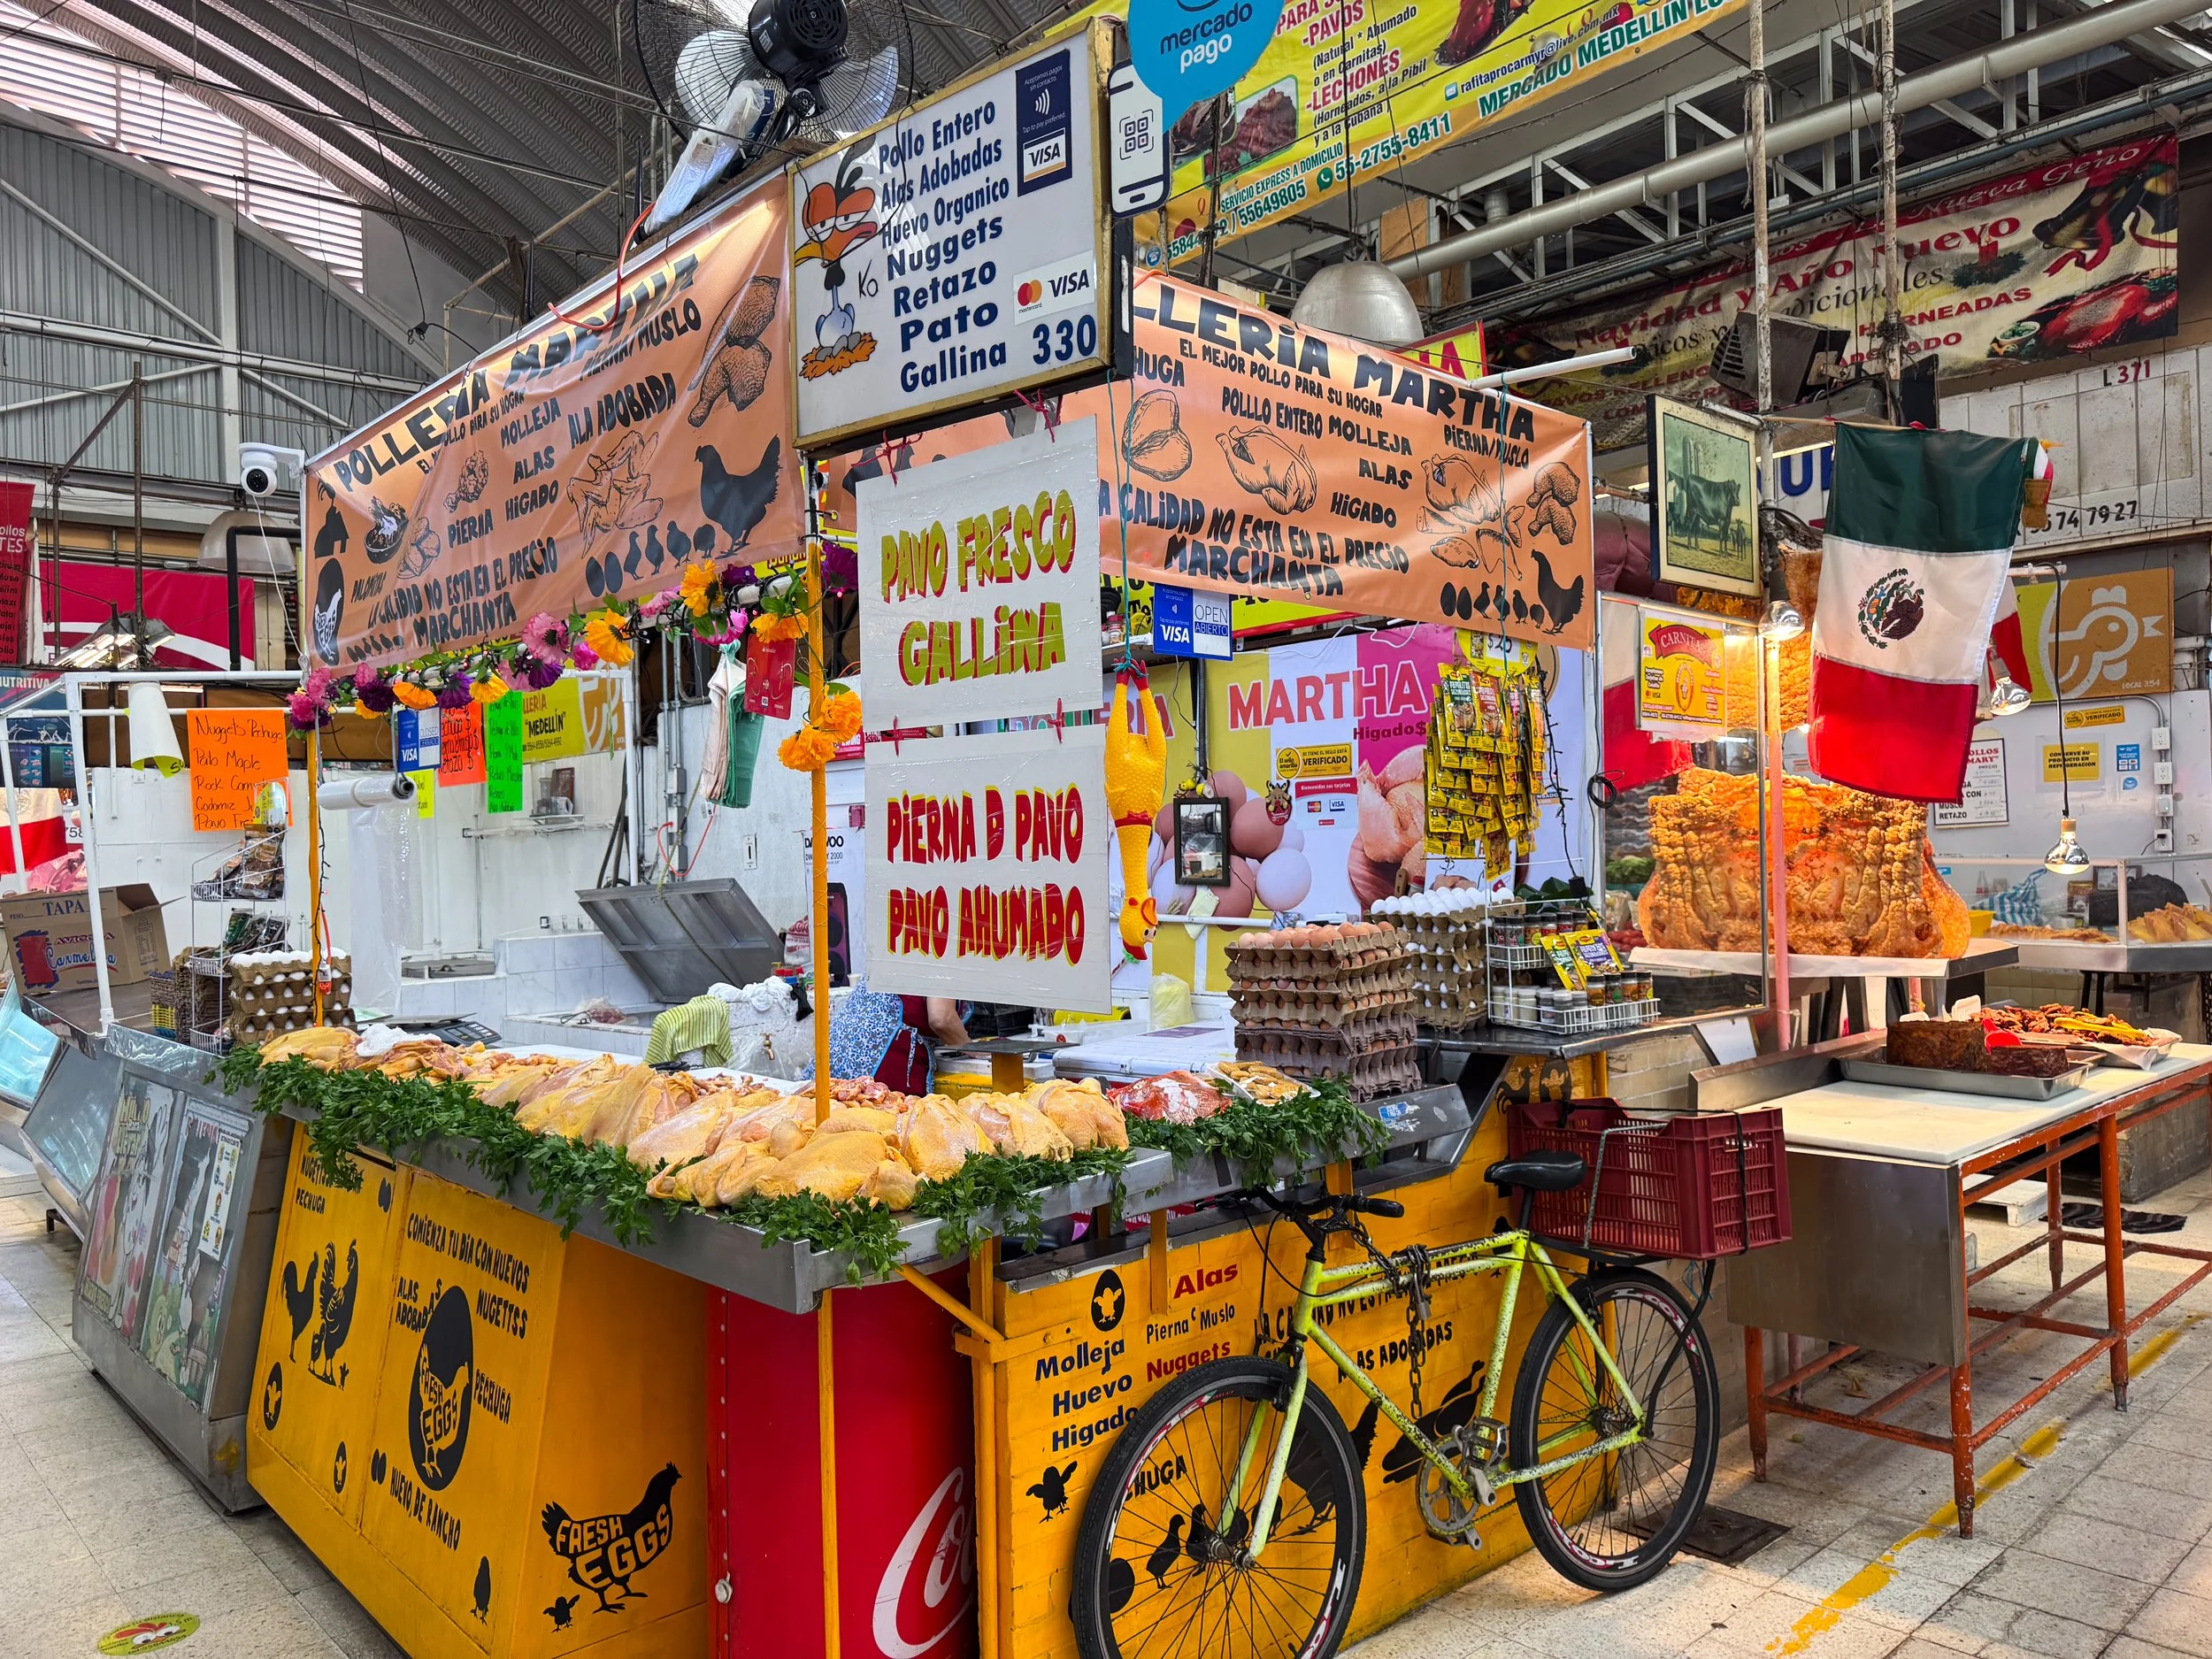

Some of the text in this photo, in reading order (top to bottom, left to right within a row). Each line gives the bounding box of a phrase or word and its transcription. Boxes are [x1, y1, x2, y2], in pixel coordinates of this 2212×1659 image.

[1159, 2, 1253, 56] mercado
[1276, 3, 1318, 35] PARA
[1312, 5, 1417, 71] (Natural Ahumado
[1024, 65, 1063, 86] Aceptamos pagos
[1179, 33, 1233, 74] pago
[1323, 71, 1334, 83] en
[1402, 58, 1427, 83] Pibil
[1478, 0, 1688, 119] MERCADO MEDELLIN
[1305, 49, 1401, 112] -LECHONES
[879, 101, 995, 174] Pollo Entero
[1028, 142, 1061, 167] VISA
[1334, 111, 1452, 181] 55-2755-8411
[880, 135, 1002, 212] Alas Adobadas
[1220, 142, 1343, 213] SERVICIO EXPRESS DOMICILIO
[881, 176, 1010, 250] Huevo Organico
[1238, 180, 1306, 228] 55649805
[887, 215, 1003, 280] Nuggets
[894, 261, 997, 318] Retazo
[1018, 303, 1042, 313] mastercard
[1048, 269, 1090, 297] VISA
[1576, 291, 1723, 349] Navidad
[1770, 258, 1853, 298] Año
[900, 302, 999, 353] Pato
[1859, 286, 2032, 337] HRNEADAS
[900, 314, 1097, 393] Gallina 330
[1179, 338, 1197, 359] EL
[1202, 344, 1246, 374] MEJOR
[1249, 361, 1291, 389] POLLO
[1294, 375, 1324, 399] PARA
[1327, 388, 1342, 406] SU
[1346, 391, 1383, 419] HOGAR
[2116, 358, 2152, 385] 371
[500, 397, 562, 449] MOLLEJA
[567, 372, 677, 449] ALA ADOBADA
[1222, 386, 1271, 426] POLLLO
[1275, 401, 1324, 441] ENTERO
[1328, 414, 1413, 457] MOLLEJA
[1354, 353, 1535, 442] MARTHA
[513, 446, 555, 485] ALAS
[1358, 457, 1413, 490] ALAS
[504, 480, 559, 522] HiGADO
[1330, 491, 1397, 528] HiGADO
[881, 520, 949, 603] PAVO
[956, 488, 1077, 592] FRESCO
[1121, 482, 1205, 535] CALiDAD
[1207, 506, 1236, 545] NO
[1239, 514, 1286, 553] ESTA
[1288, 525, 1314, 560] EN
[1317, 531, 1340, 565] EL
[1344, 537, 1409, 574] PRECiO
[425, 578, 442, 611] NO
[447, 568, 473, 606] ESTA
[493, 557, 507, 591] EL
[1164, 534, 1344, 596] MARCHANTA
[413, 591, 518, 648] MARCHANTA
[1160, 625, 1190, 643] VISA
[1194, 605, 1228, 624] OPEN
[1194, 622, 1228, 636] ABIERTO
[898, 601, 1066, 687] GALLiNA
[1228, 661, 1427, 730] MARTHA
[2144, 678, 2161, 688] 354
[420, 726, 439, 738] CLOSED
[2085, 710, 2122, 720] VERIFICADO
[227, 750, 261, 772] Maple
[402, 748, 418, 762] VISA
[1302, 755, 1348, 767] VERIFICADO
[887, 782, 1084, 865] PiERNA D PAVO
[1939, 811, 1968, 820] RETAZO
[42, 899, 84, 917] TAPA
[887, 883, 1086, 966] PAVO AHUMADO
[296, 1188, 326, 1215] PECHUGA
[407, 1213, 447, 1253] COMiENZA
[448, 1230, 458, 1257] TU
[475, 1238, 494, 1272] CON
[494, 1248, 530, 1294] HUEVOS
[396, 1279, 442, 1333] ADOBADAS
[397, 1276, 419, 1302] ALAS
[1172, 1263, 1238, 1299] Alas
[476, 1288, 527, 1339] NUGETTSS
[1146, 1317, 1189, 1345] Pierna
[1200, 1302, 1235, 1331] Muslo
[420, 1356, 443, 1405] FRESH
[1034, 1338, 1125, 1381] Molleja
[1146, 1341, 1231, 1382] Nuggets
[421, 1389, 457, 1446] EGGS
[475, 1369, 511, 1425] PECHUGA
[1053, 1374, 1133, 1417] Huevo
[1051, 1405, 1139, 1453] Higado
[412, 1486, 461, 1551] DE RANCHO
[556, 1516, 623, 1555] FRESH
[575, 1503, 670, 1589] EGGS
